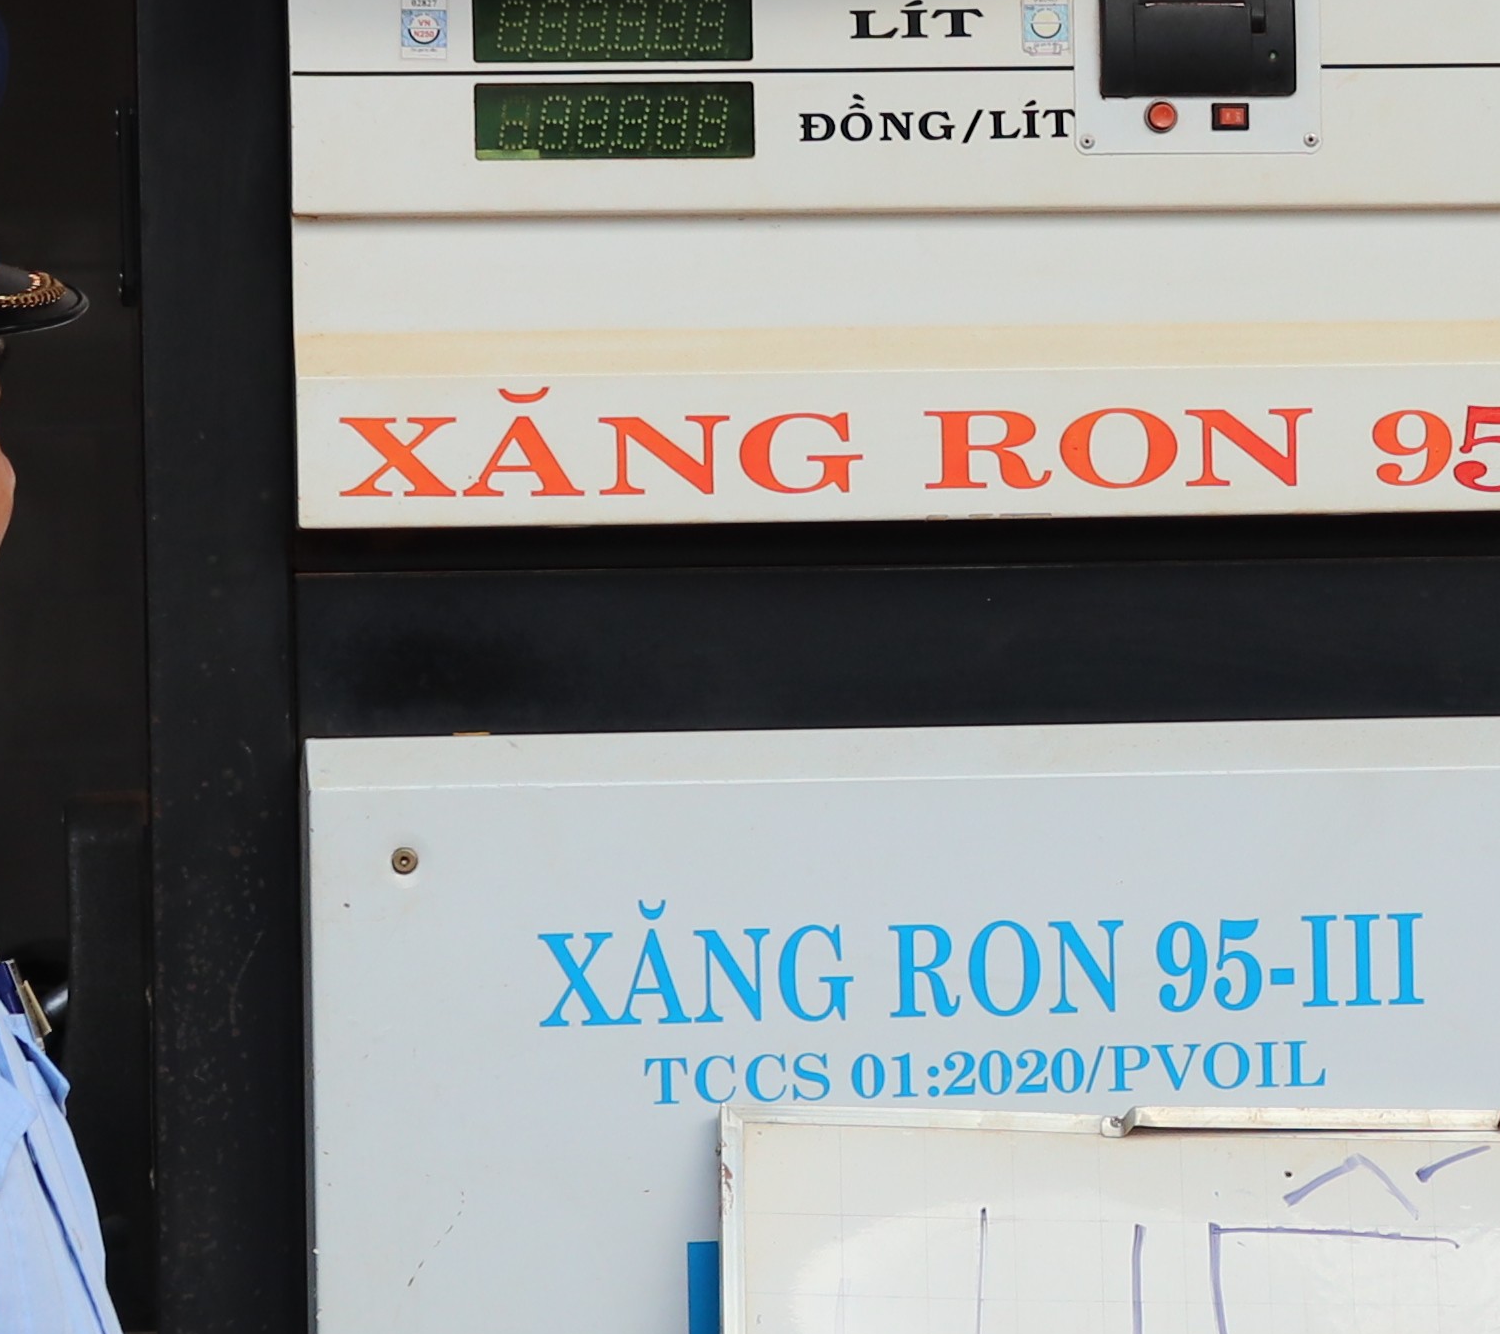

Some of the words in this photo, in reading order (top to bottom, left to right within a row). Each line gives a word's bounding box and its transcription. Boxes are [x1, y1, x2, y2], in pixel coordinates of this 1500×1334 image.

[850, 0, 983, 41] LÍT
[798, 92, 1076, 145] ĐỒNG/LÍT
[339, 387, 864, 498] XĂNG
[922, 407, 1312, 489] RON
[538, 900, 853, 1029] XĂNG
[888, 920, 1125, 1020] RON
[1156, 912, 1426, 1012] 95-III
[643, 1052, 832, 1107] TCCS
[850, 1039, 1328, 1101] 01:2020/PVOIL
